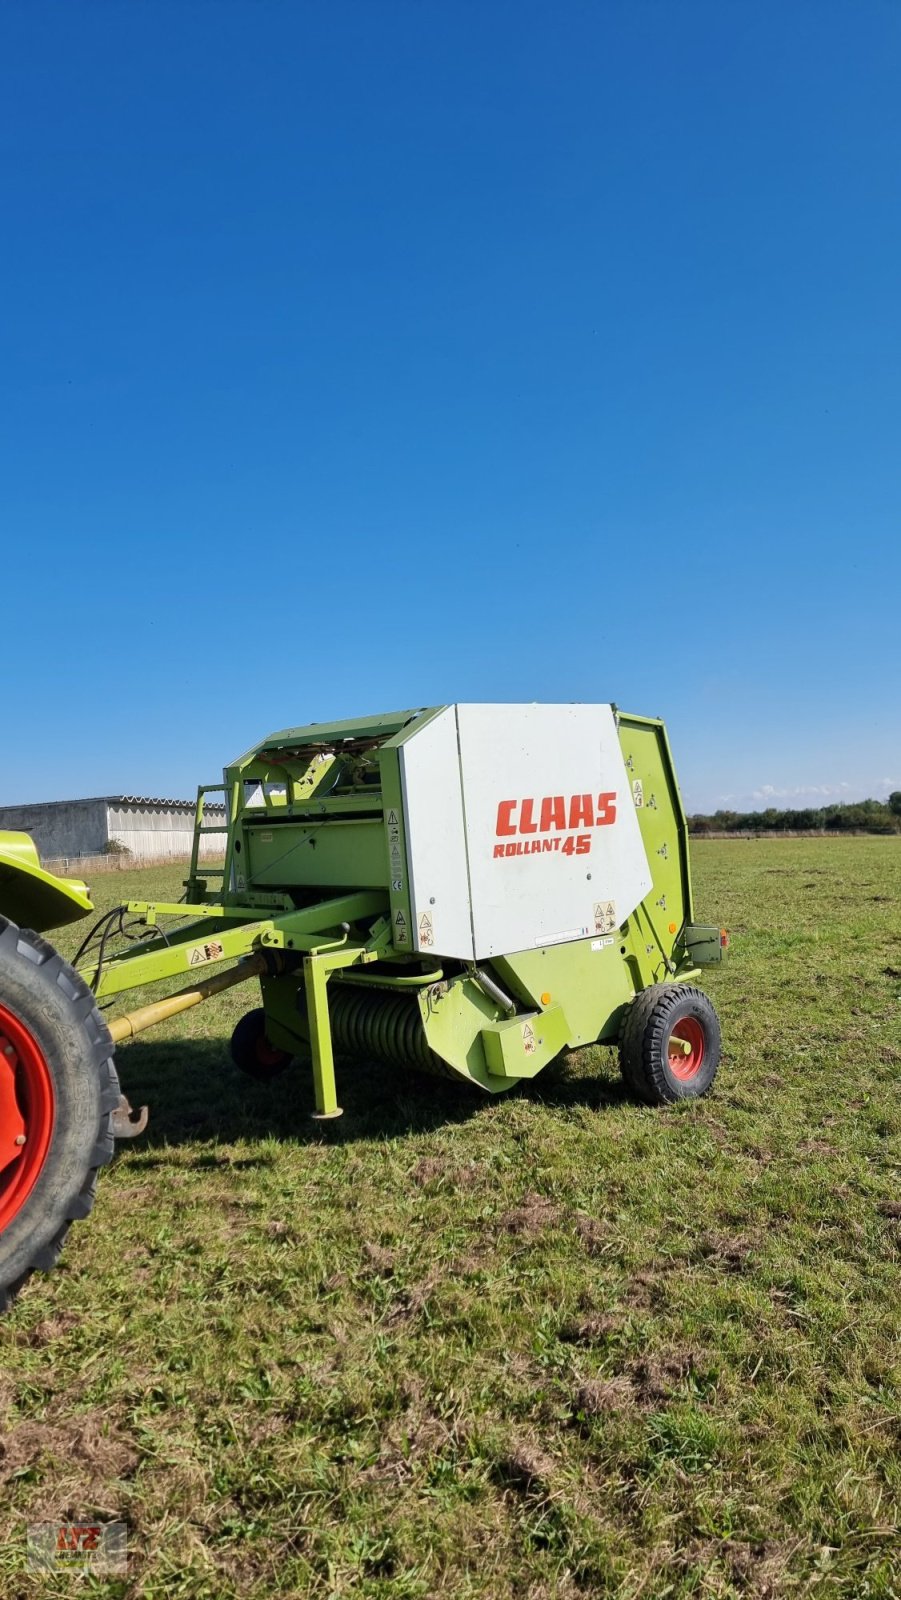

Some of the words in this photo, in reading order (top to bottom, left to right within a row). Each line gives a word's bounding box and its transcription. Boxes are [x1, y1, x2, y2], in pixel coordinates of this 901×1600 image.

[495, 792, 617, 836] CLAAS
[493, 837, 561, 858] ROLLANT
[561, 834, 591, 856] 45
